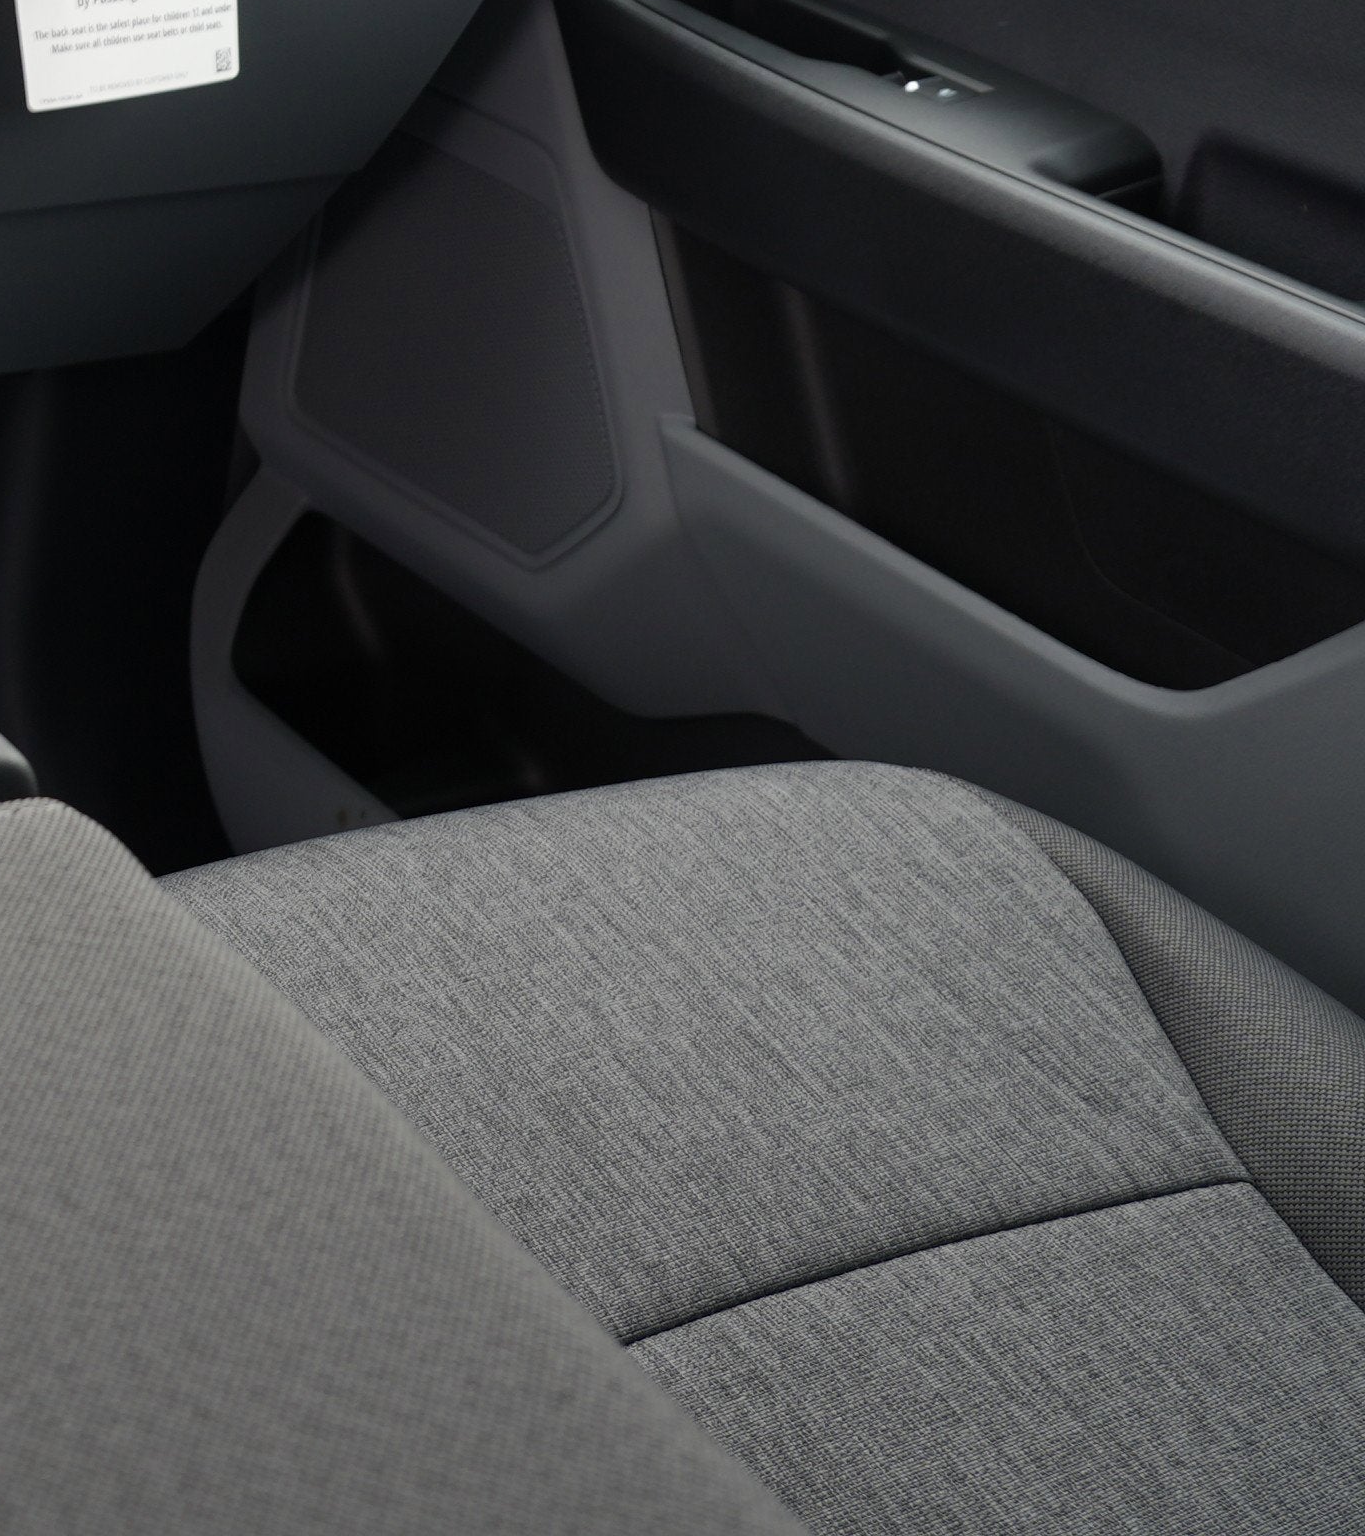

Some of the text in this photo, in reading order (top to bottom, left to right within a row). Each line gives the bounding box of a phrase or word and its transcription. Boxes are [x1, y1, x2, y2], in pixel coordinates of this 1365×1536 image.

[34, 30, 49, 41] The
[51, 26, 69, 39] back
[71, 25, 86, 36] seat
[96, 22, 108, 32] the
[110, 18, 130, 30] safest
[132, 15, 150, 29] place
[164, 9, 190, 22] children
[51, 42, 72, 54] Make
[75, 41, 90, 51] sure
[103, 33, 132, 46] children
[147, 30, 161, 40] seat
[162, 27, 179, 38] belts
[189, 21, 205, 34] child
